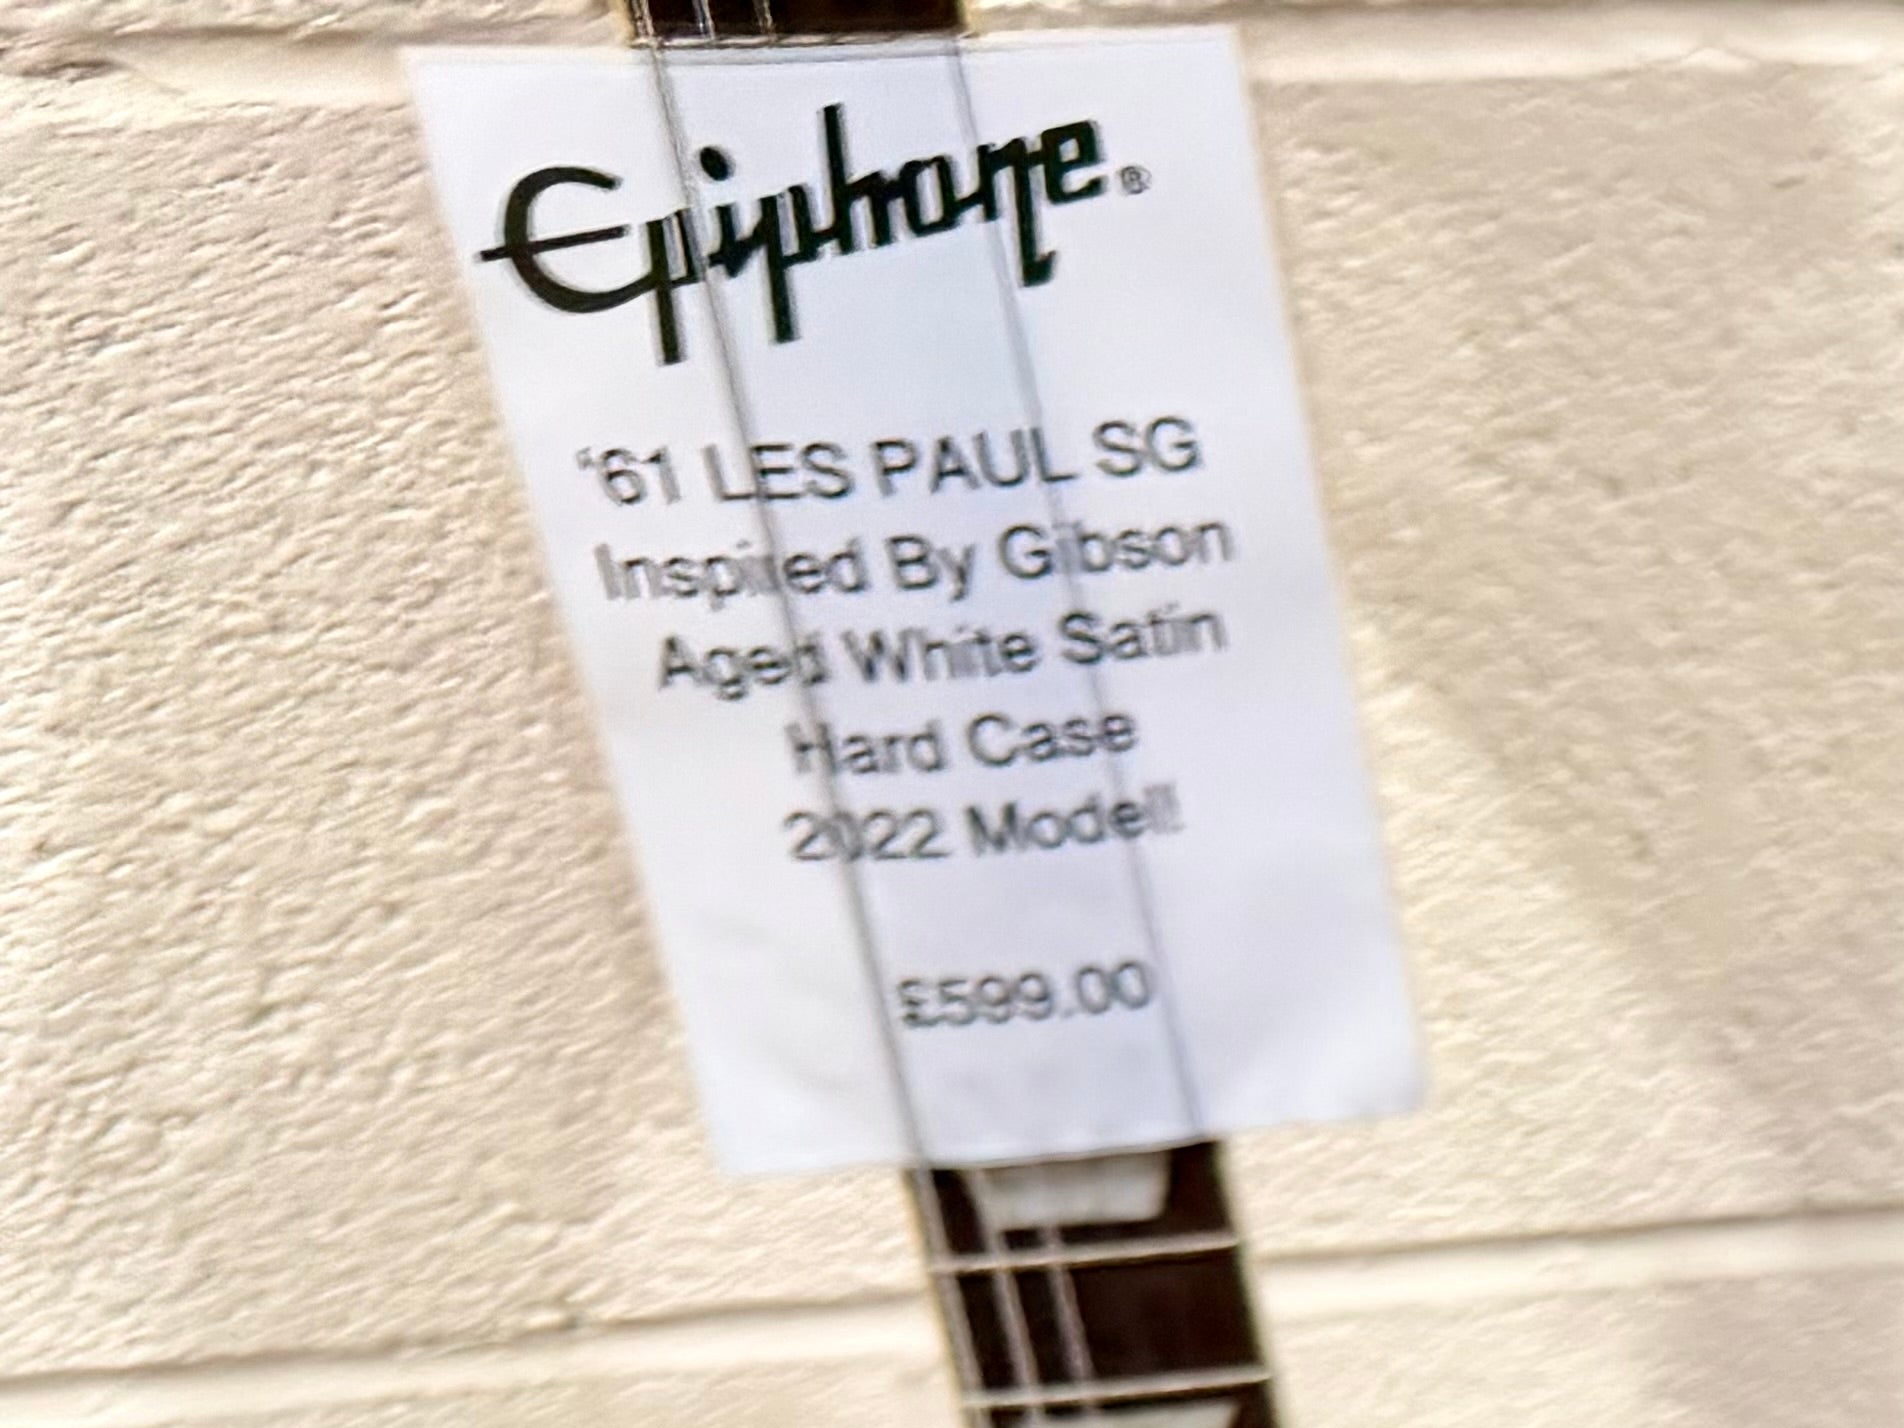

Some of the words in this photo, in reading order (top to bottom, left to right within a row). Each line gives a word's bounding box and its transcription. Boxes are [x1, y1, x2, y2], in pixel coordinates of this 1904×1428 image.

[703, 440, 850, 502] LES
[871, 426, 1075, 496] PAUL
[1092, 415, 1200, 476] SG
[593, 539, 866, 610] Inspired
[885, 534, 975, 601] By
[1000, 519, 1232, 579] Gibson
[658, 634, 830, 701] Aged
[843, 626, 1039, 683] White
[1056, 602, 1227, 664] Satin
[787, 718, 943, 774] Hard
[966, 706, 1136, 764] Case
[784, 808, 949, 862] 2022
[898, 960, 1148, 1028] £599.00
